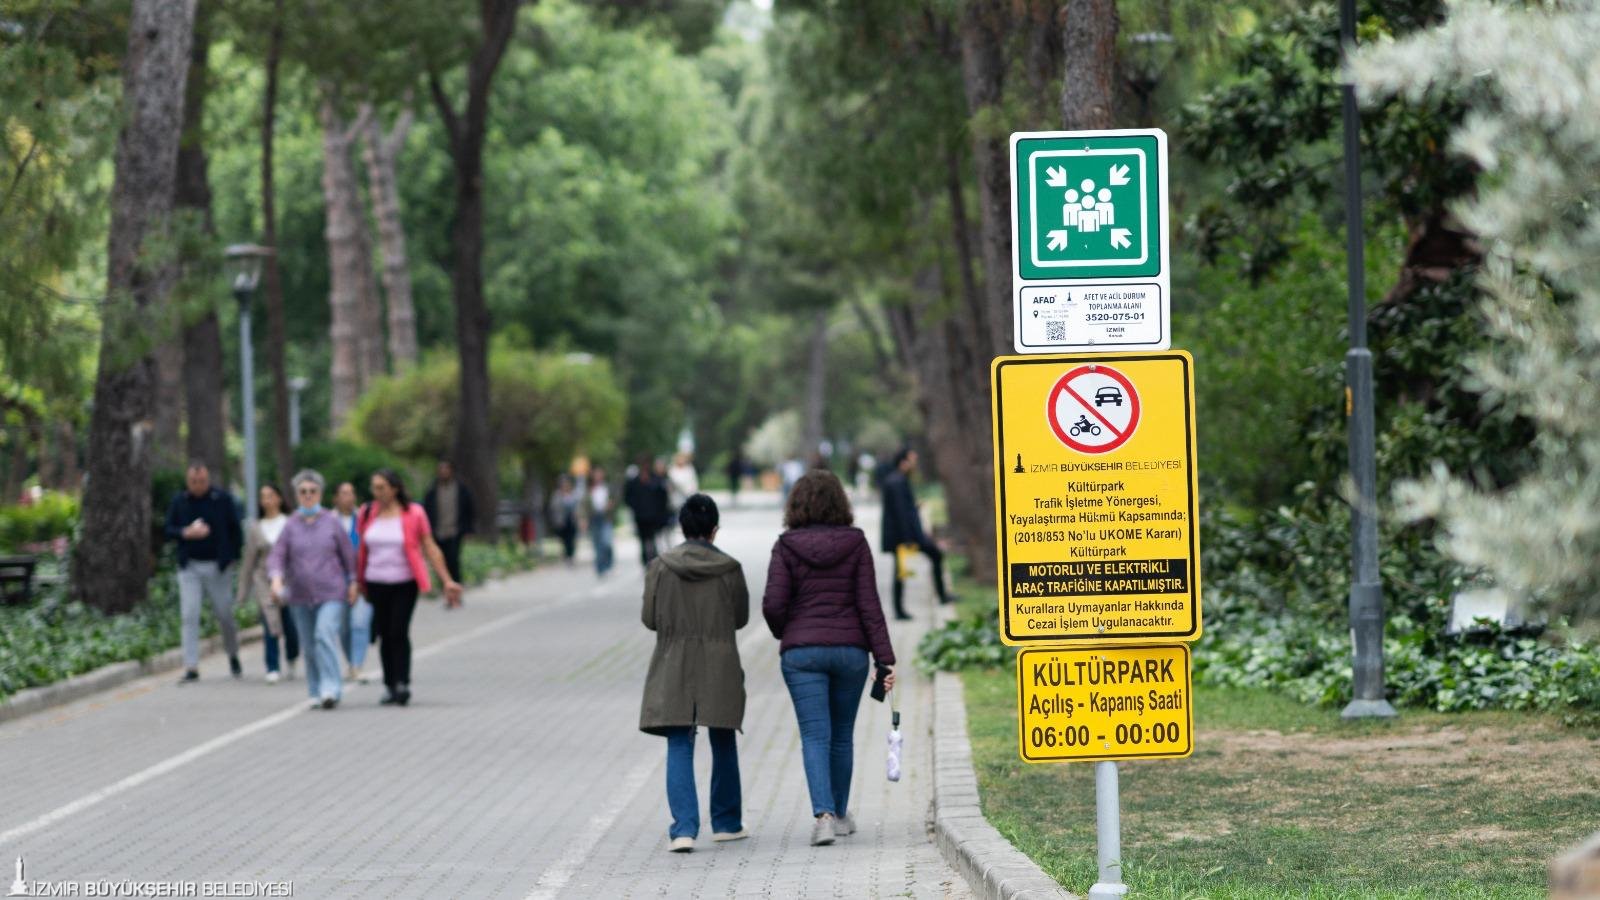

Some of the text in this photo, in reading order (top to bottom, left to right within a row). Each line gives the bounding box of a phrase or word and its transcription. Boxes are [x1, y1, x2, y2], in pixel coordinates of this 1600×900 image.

[1061, 462, 1122, 472] BÜYÜKŞEHİR
[1126, 460, 1181, 470] BELEDİYESİ
[1068, 481, 1124, 493] Kültürpark
[1034, 495, 1161, 510] Trafik İşletme Yönergesi,
[1010, 513, 1075, 527] Yayalaştırma
[1079, 512, 1115, 522] Hükmü
[1014, 531, 1064, 545] (2018/853
[1100, 529, 1142, 540] UKOME
[1146, 528, 1182, 540] Kararı)
[1071, 546, 1126, 559] Kültürpark
[1029, 560, 1169, 576] MOTORLU VE ELEKTRİKLİ
[1015, 578, 1184, 595] ARAÇ TRAFİĞİNE KAPATILMIŞTIR.
[1016, 600, 1184, 614] Kurallara Uymayanlar Hakkında
[1027, 616, 1174, 631] Cezai İşlem Uygulanacaktır.
[1033, 656, 1174, 686] KÜLTÜRPARK
[1029, 693, 1074, 719] Açılış
[1090, 692, 1144, 717] Kapanış
[1149, 689, 1182, 710] Saati
[1031, 725, 1089, 747] 06:00
[1116, 722, 1180, 744] 00:00
